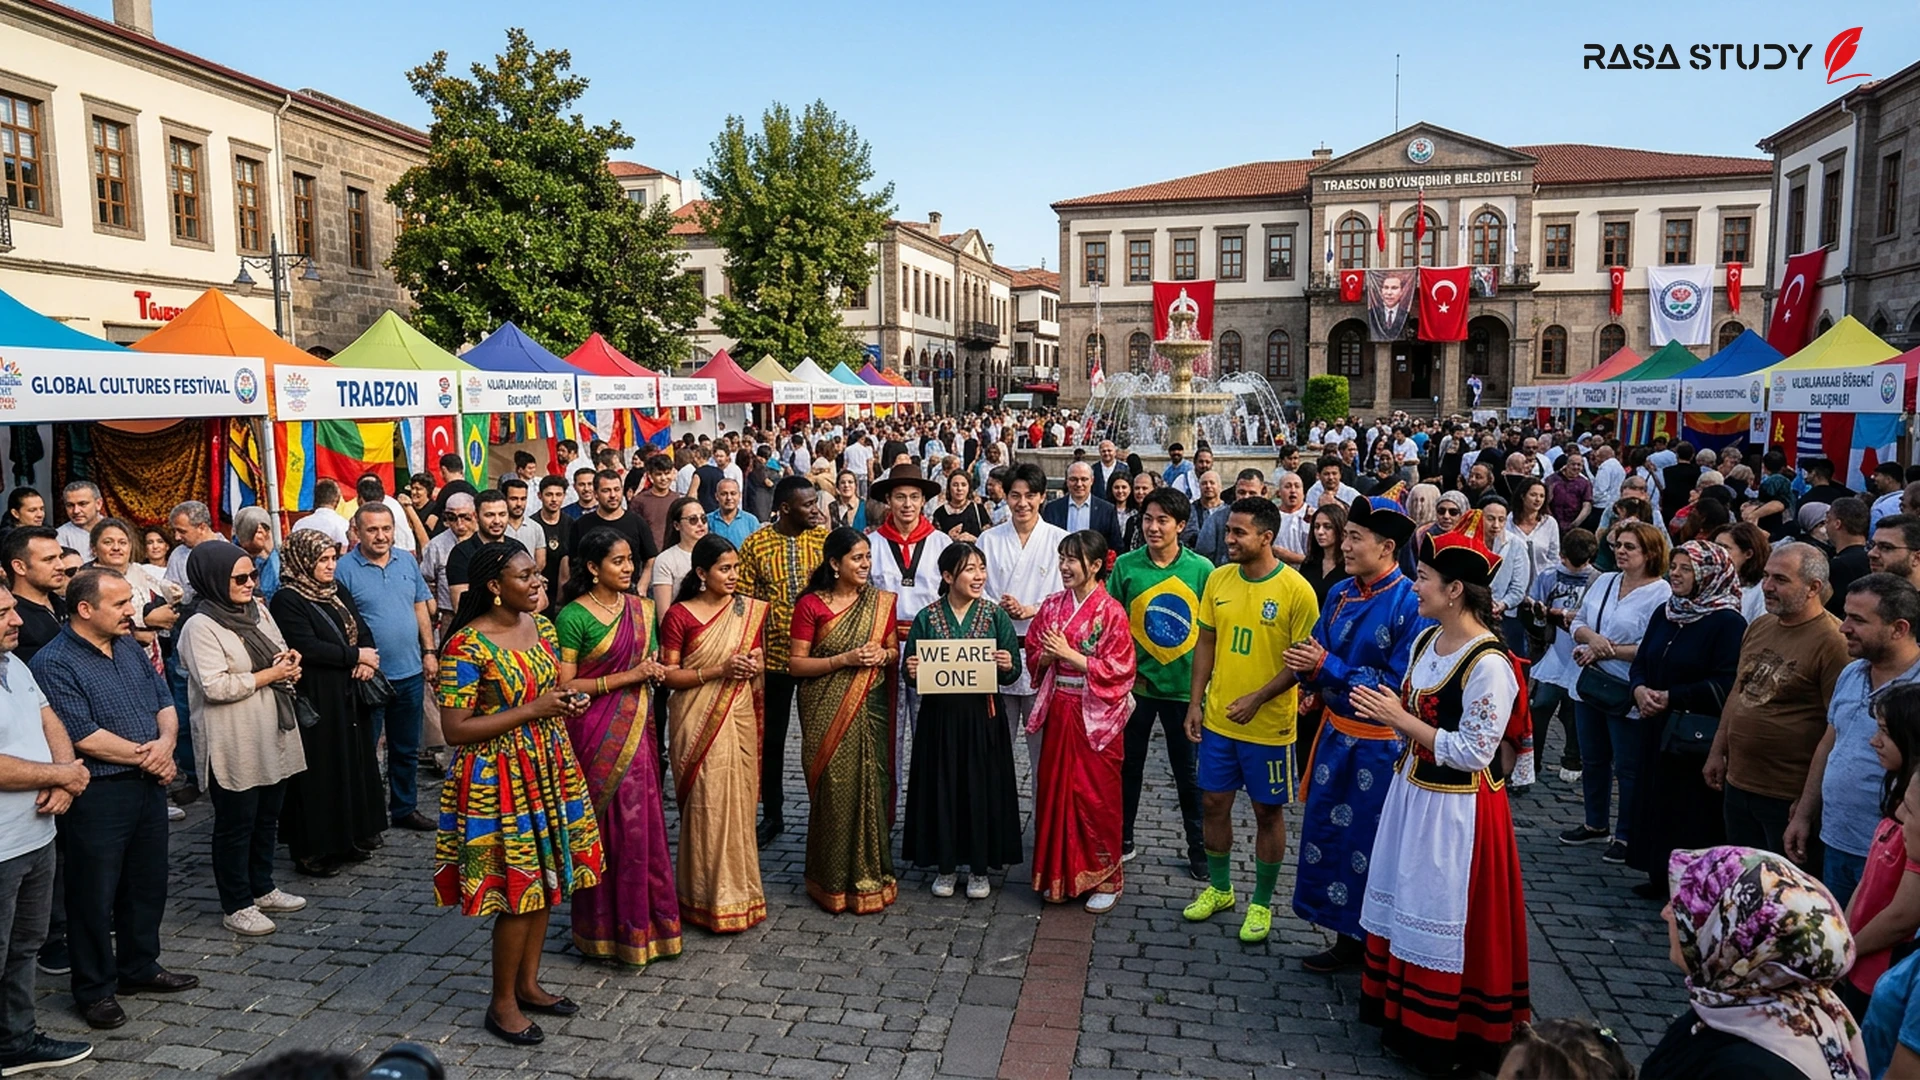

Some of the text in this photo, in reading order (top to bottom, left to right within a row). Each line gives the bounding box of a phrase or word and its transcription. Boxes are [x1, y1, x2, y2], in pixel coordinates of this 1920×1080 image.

[31, 376, 97, 394] GLOBAL
[99, 377, 171, 394] CULTURES
[336, 380, 419, 407] TRABZON
[1230, 625, 1253, 656] 10
[920, 646, 992, 662] WE ARE
[935, 669, 978, 687] ONE
